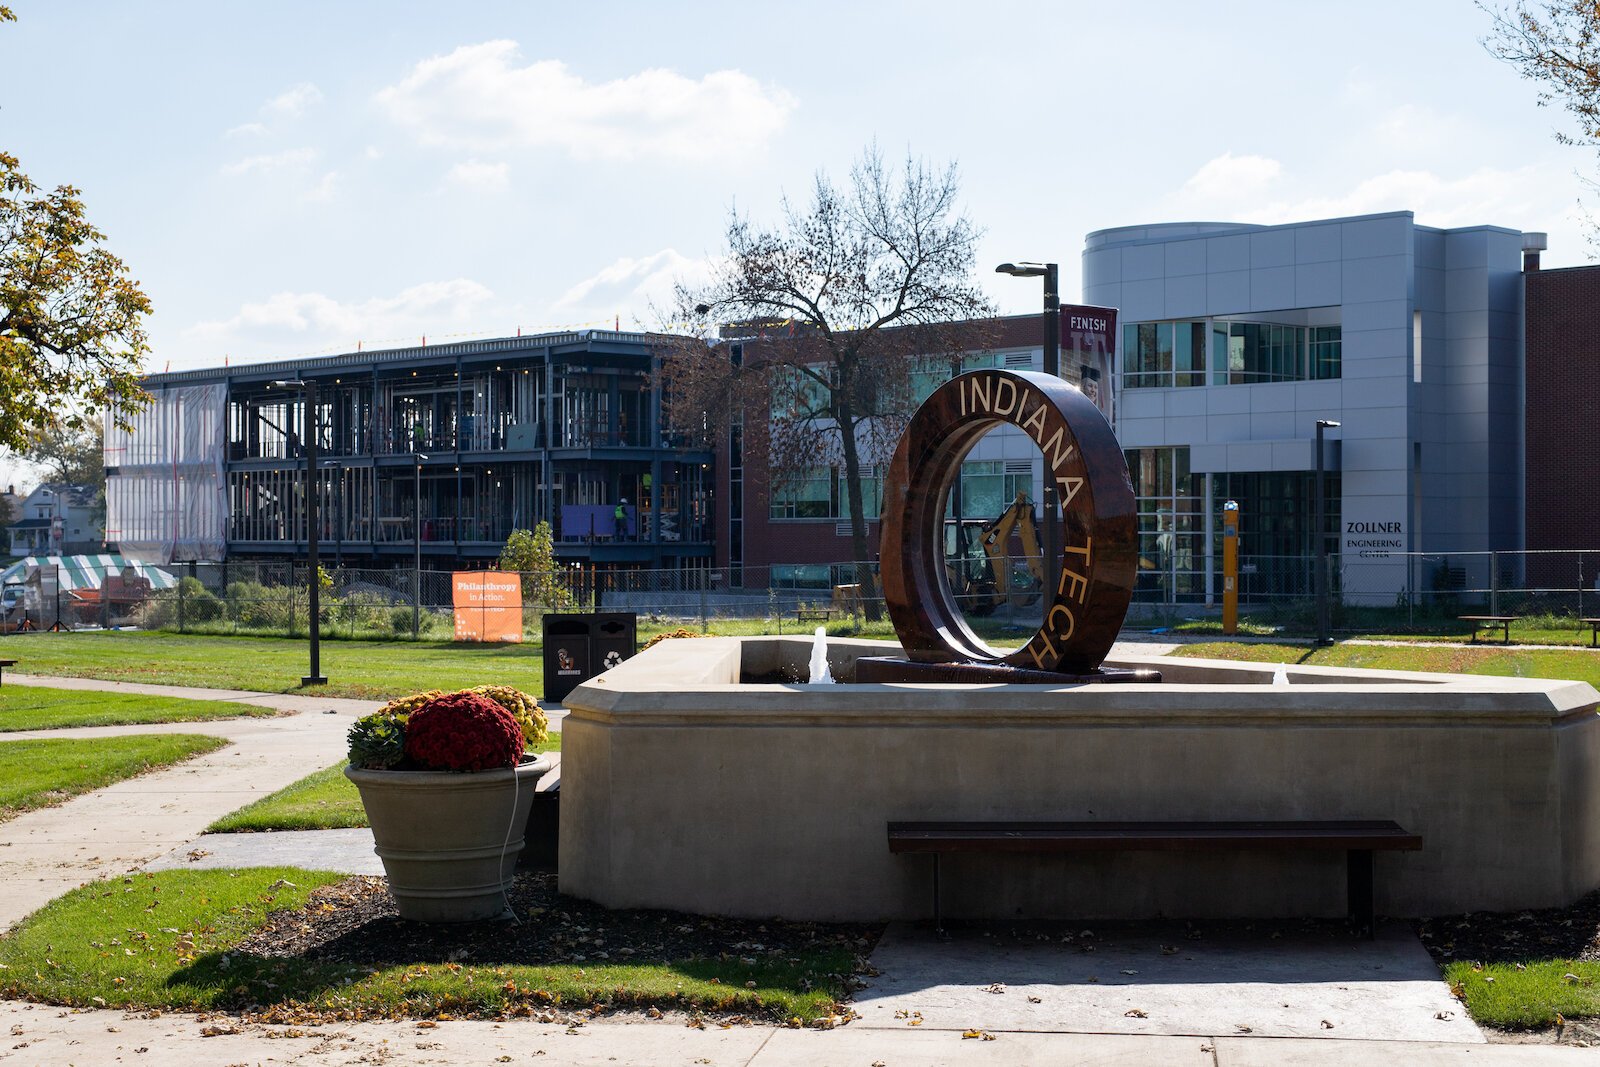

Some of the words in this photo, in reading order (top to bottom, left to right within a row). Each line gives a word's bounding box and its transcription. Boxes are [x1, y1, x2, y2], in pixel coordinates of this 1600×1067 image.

[1070, 316, 1106, 331] FINISH
[960, 375, 1084, 509] INDIANA
[1028, 536, 1092, 669] TECH
[1346, 522, 1401, 533] ZOLLNER
[1359, 550, 1389, 558] CENTER
[457, 582, 517, 592] Philanthropy
[469, 593, 477, 601] in
